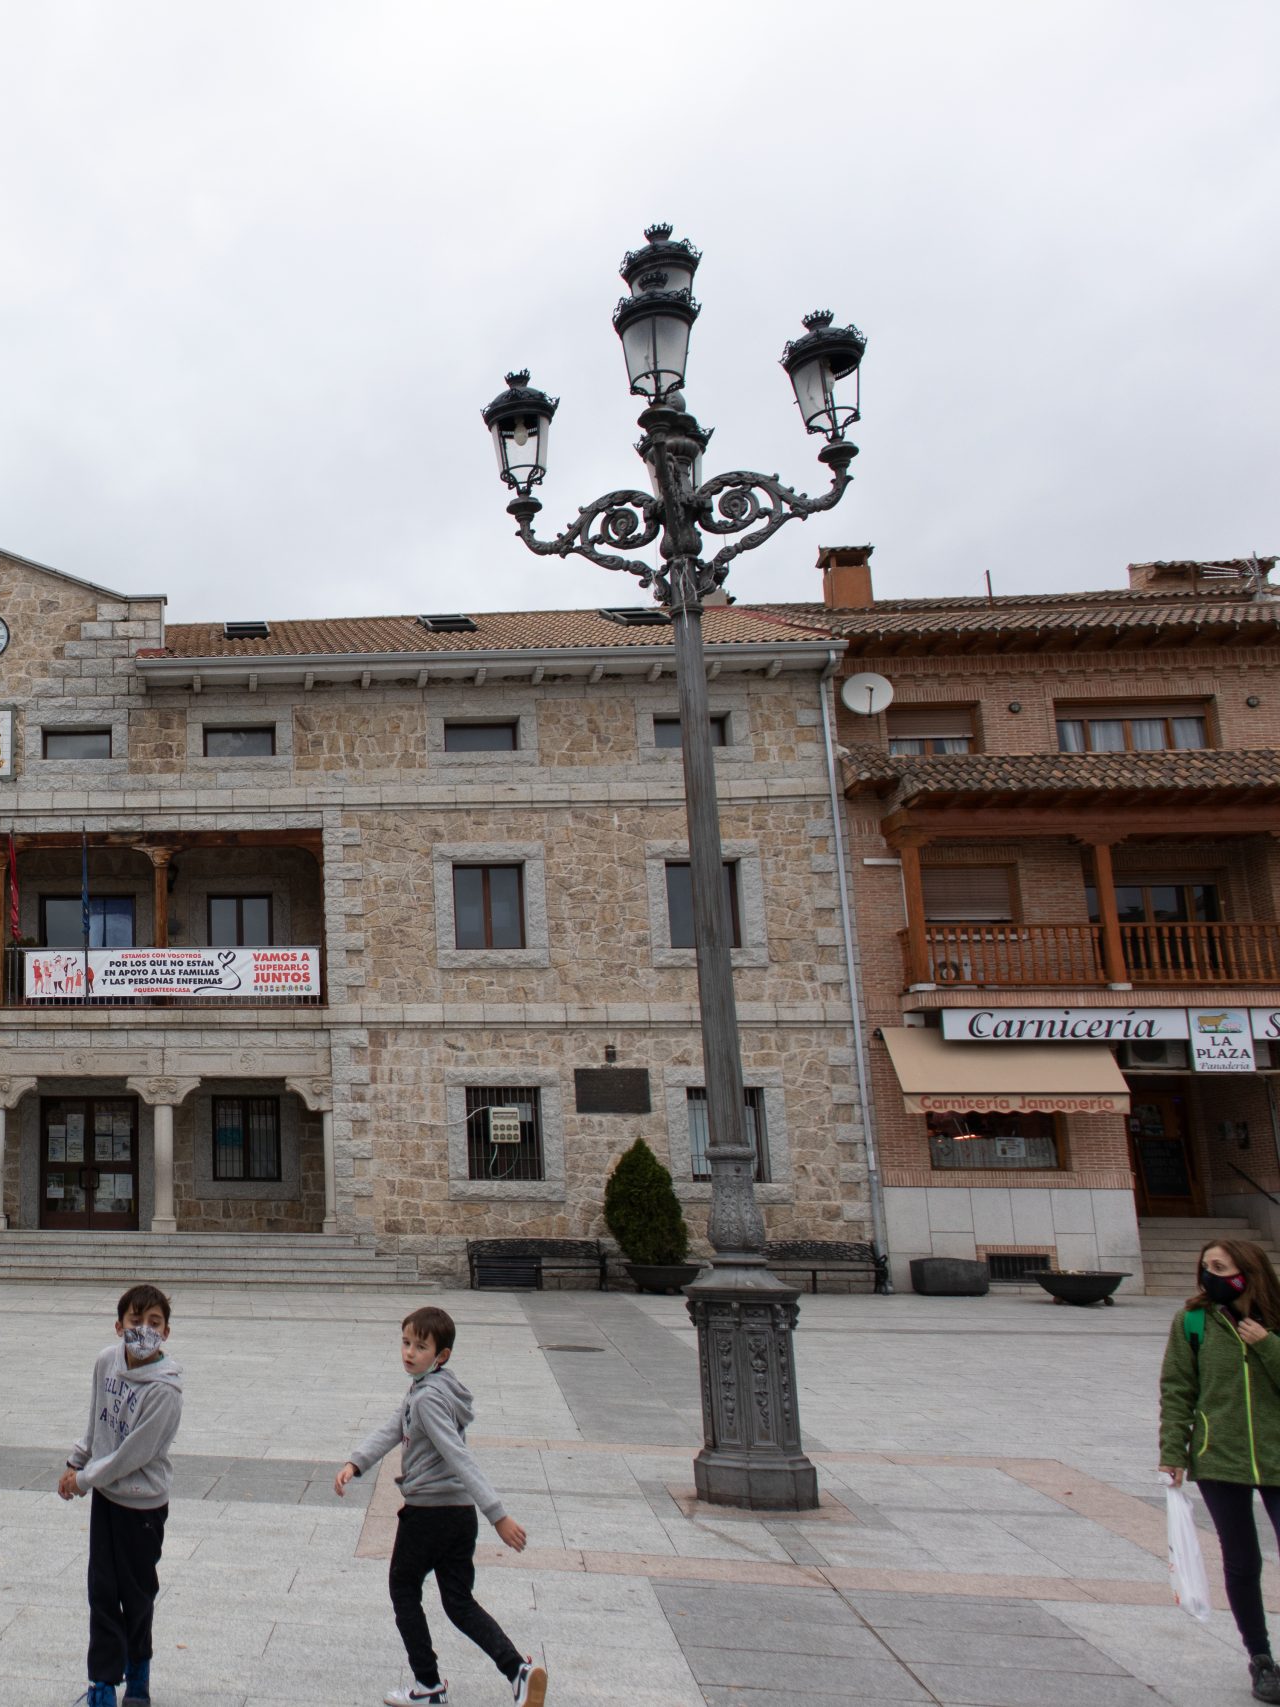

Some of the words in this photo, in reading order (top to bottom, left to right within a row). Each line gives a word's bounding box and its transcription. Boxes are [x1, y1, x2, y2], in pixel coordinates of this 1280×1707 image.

[253, 953, 297, 961] VAMOS
[301, 953, 310, 961] A
[186, 958, 214, 967] ESTÁN
[253, 972, 311, 983] JUNTOS
[968, 1010, 1162, 1038] Carnicería
[1210, 1036, 1233, 1046] LA
[1196, 1049, 1251, 1058] PLAZA
[921, 1095, 1010, 1110] Carnicería
[1019, 1095, 1115, 1110] Jamonería
